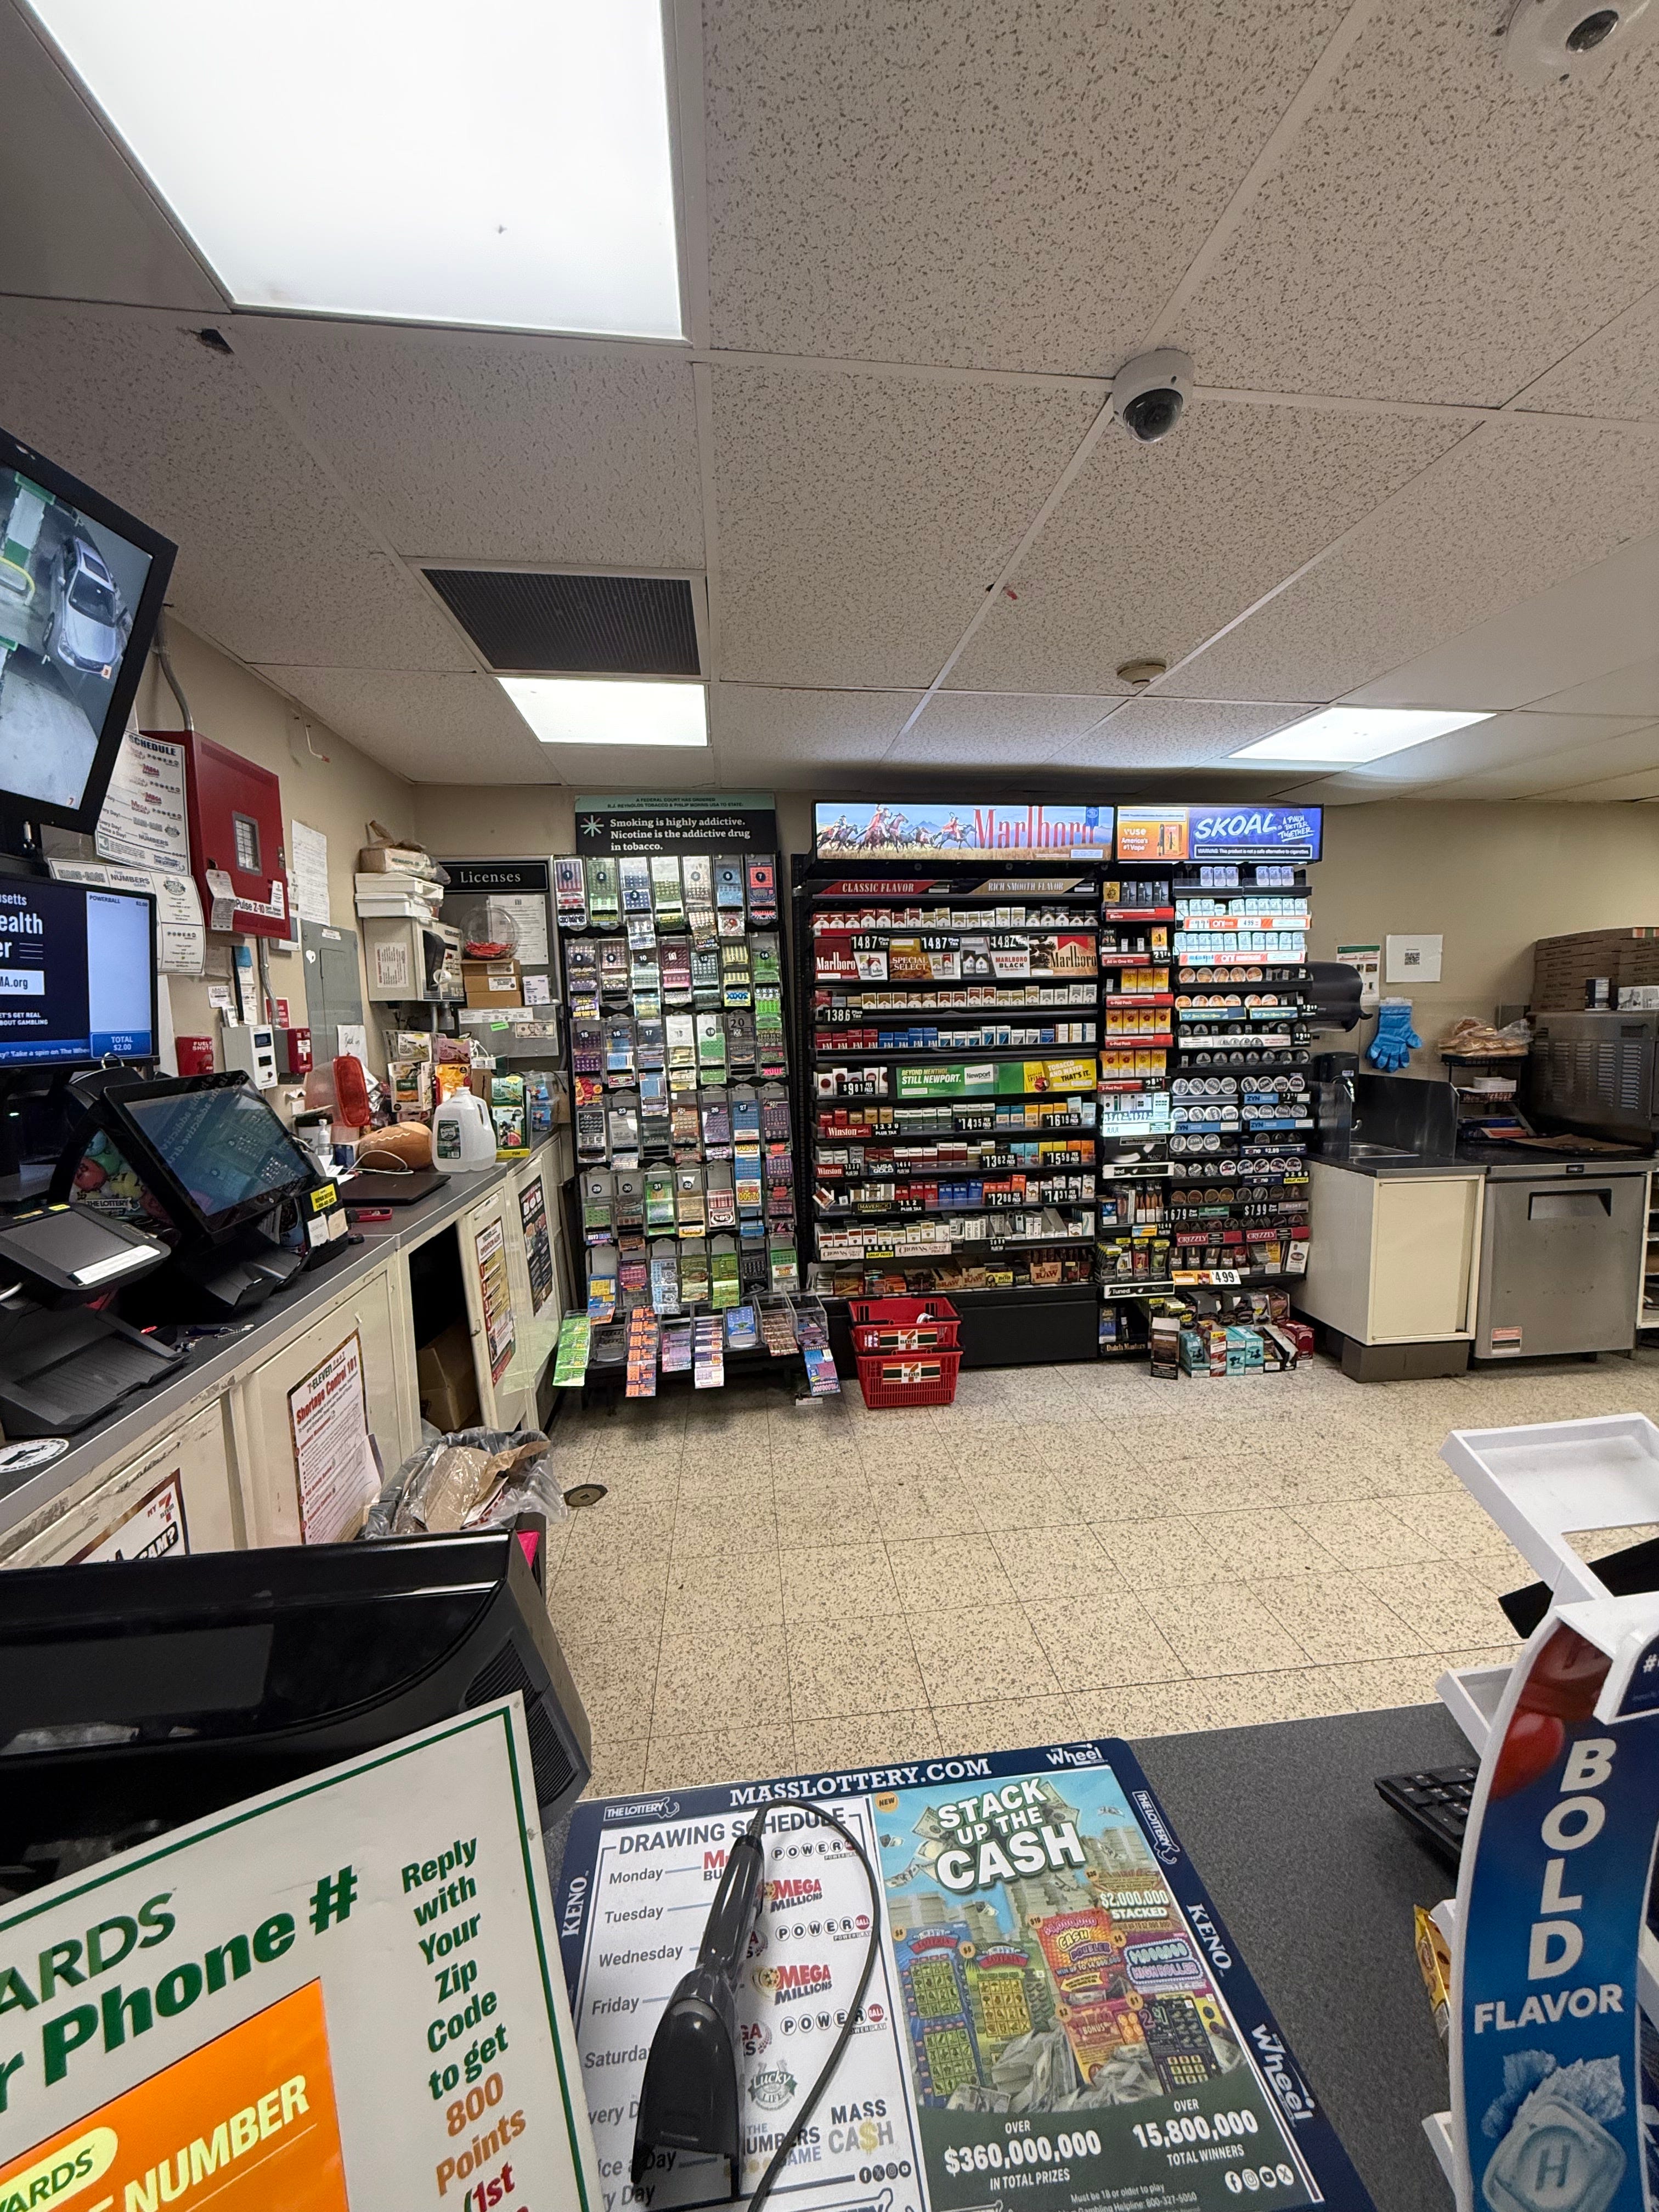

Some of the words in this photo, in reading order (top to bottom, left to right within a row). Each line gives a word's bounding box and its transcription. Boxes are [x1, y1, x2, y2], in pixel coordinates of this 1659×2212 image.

[128, 735, 176, 755] SCHEDULE
[610, 817, 654, 828] Smoking
[655, 817, 664, 826] is
[665, 817, 697, 828] highly
[698, 817, 746, 826] addictive.
[973, 805, 1096, 849] Marlboro
[1194, 812, 1278, 840] SKOAL
[1285, 821, 1308, 830] BETTER
[610, 830, 652, 839] Nicotine
[654, 830, 663, 839] is
[664, 830, 681, 838] the
[682, 829, 726, 838] addictive
[727, 828, 751, 839] drug
[611, 842, 621, 851] in
[623, 842, 663, 850] tobacco.
[111, 874, 150, 885] NUMBERS
[460, 871, 521, 883] Licenses
[842, 883, 878, 893] CLASSIC
[881, 882, 914, 892] FLAVOR
[988, 882, 1006, 892] RICH
[1007, 882, 1036, 891] SMOOTH
[1038, 882, 1064, 891] FLAVOR
[816, 952, 856, 971] Marlboro
[892, 956, 927, 964] SPECIAL
[1051, 946, 1097, 968] Marlboro
[966, 1071, 991, 1079] Newport
[1047, 1060, 1075, 1071] TOBACCO
[1049, 1069, 1062, 1078] AND
[1062, 1064, 1083, 1075] WATER
[1060, 1071, 1082, 1082] THAT'S
[1082, 1069, 1091, 1078] IT.
[901, 1075, 922, 1085] STILL
[923, 1074, 962, 1084] NEWPORT.
[827, 1127, 857, 1136] Winston
[817, 1166, 842, 1175] Winston
[1177, 1235, 1207, 1244] GRIZZLY
[1246, 1231, 1276, 1240] GRIZZLY
[1036, 1269, 1059, 1279] RAW
[1106, 1344, 1124, 1352] Dutch
[296, 1390, 325, 1424] Shortage
[326, 1361, 347, 1396] Control
[347, 1355, 357, 1375] 101
[1046, 1743, 1103, 1766] Wheel
[730, 1757, 992, 1807] MASSLOTTERY.COM
[607, 1806, 624, 1819] THE
[624, 1802, 664, 1815] LOTTERY
[878, 1796, 895, 1807] NEW
[938, 1778, 1048, 1829] STACK
[957, 1822, 988, 1845] UP
[995, 1806, 1043, 1833] THE
[1136, 1792, 1149, 1810] THE
[1144, 1807, 1171, 1847] LOTTERY
[619, 1822, 725, 1854] DRAWING
[401, 1837, 477, 1894] Reply
[936, 1821, 1086, 1889] CASH
[1527, 1737, 1617, 1980] BOLD
[609, 1868, 664, 1885] Monday
[773, 1878, 822, 1900] MEGA
[414, 1875, 477, 1927] with
[561, 1874, 588, 1940] KENO
[770, 1891, 823, 1913] MILLIONS
[605, 1906, 664, 1924] Tuesday
[1111, 1906, 1168, 1920] STACKED
[418, 1913, 481, 1966] Your
[1057, 1929, 1090, 1949] CASH
[1186, 1903, 1233, 1971] KENO
[599, 1945, 684, 1967] Wednesday
[1070, 1940, 1112, 1961] DOUBLER
[42, 1912, 296, 2088] Phone
[309, 1865, 358, 1936] #
[776, 1963, 832, 1990] MEGA
[1159, 1961, 1198, 1978] ROLLER
[435, 1959, 478, 2004] Zip
[774, 1979, 832, 2005] MILLIONS
[592, 1996, 640, 2015] Friday
[1474, 1984, 1624, 2034] FLAVOR
[427, 1991, 497, 2053] Code
[428, 2063, 459, 2101] to
[464, 2022, 509, 2083] get
[584, 2045, 652, 2069] Saturda
[753, 2070, 791, 2088] Lucky
[1251, 2023, 1316, 2121] Wheel
[446, 2072, 504, 2137] 800
[762, 2092, 785, 2103] LIFE
[1173, 2098, 1199, 2112] OVER
[831, 2099, 887, 2125] MASS
[746, 2123, 768, 2133] THE
[1005, 2120, 1031, 2134] OVER
[1132, 2109, 1260, 2149] 15,800,000
[124, 2074, 310, 2212] NUMBER
[436, 2109, 526, 2197] Points
[944, 2129, 1102, 2176] $360,000,000
[1166, 2151, 1198, 2168] TOTAL
[1199, 2143, 1245, 2163] WINNERS
[990, 2177, 1001, 2191] IN
[1002, 2172, 1034, 2189] TOTAL
[1035, 2168, 1070, 2184] PRIZES
[1070, 2193, 1090, 2203] Must
[1091, 2192, 1100, 2200] be
[1101, 2190, 1110, 2199] 18
[1111, 2190, 1120, 2198] or
[1120, 2186, 1140, 2197] older
[1140, 2186, 1148, 2194] to
[1149, 2182, 1165, 2195] play
